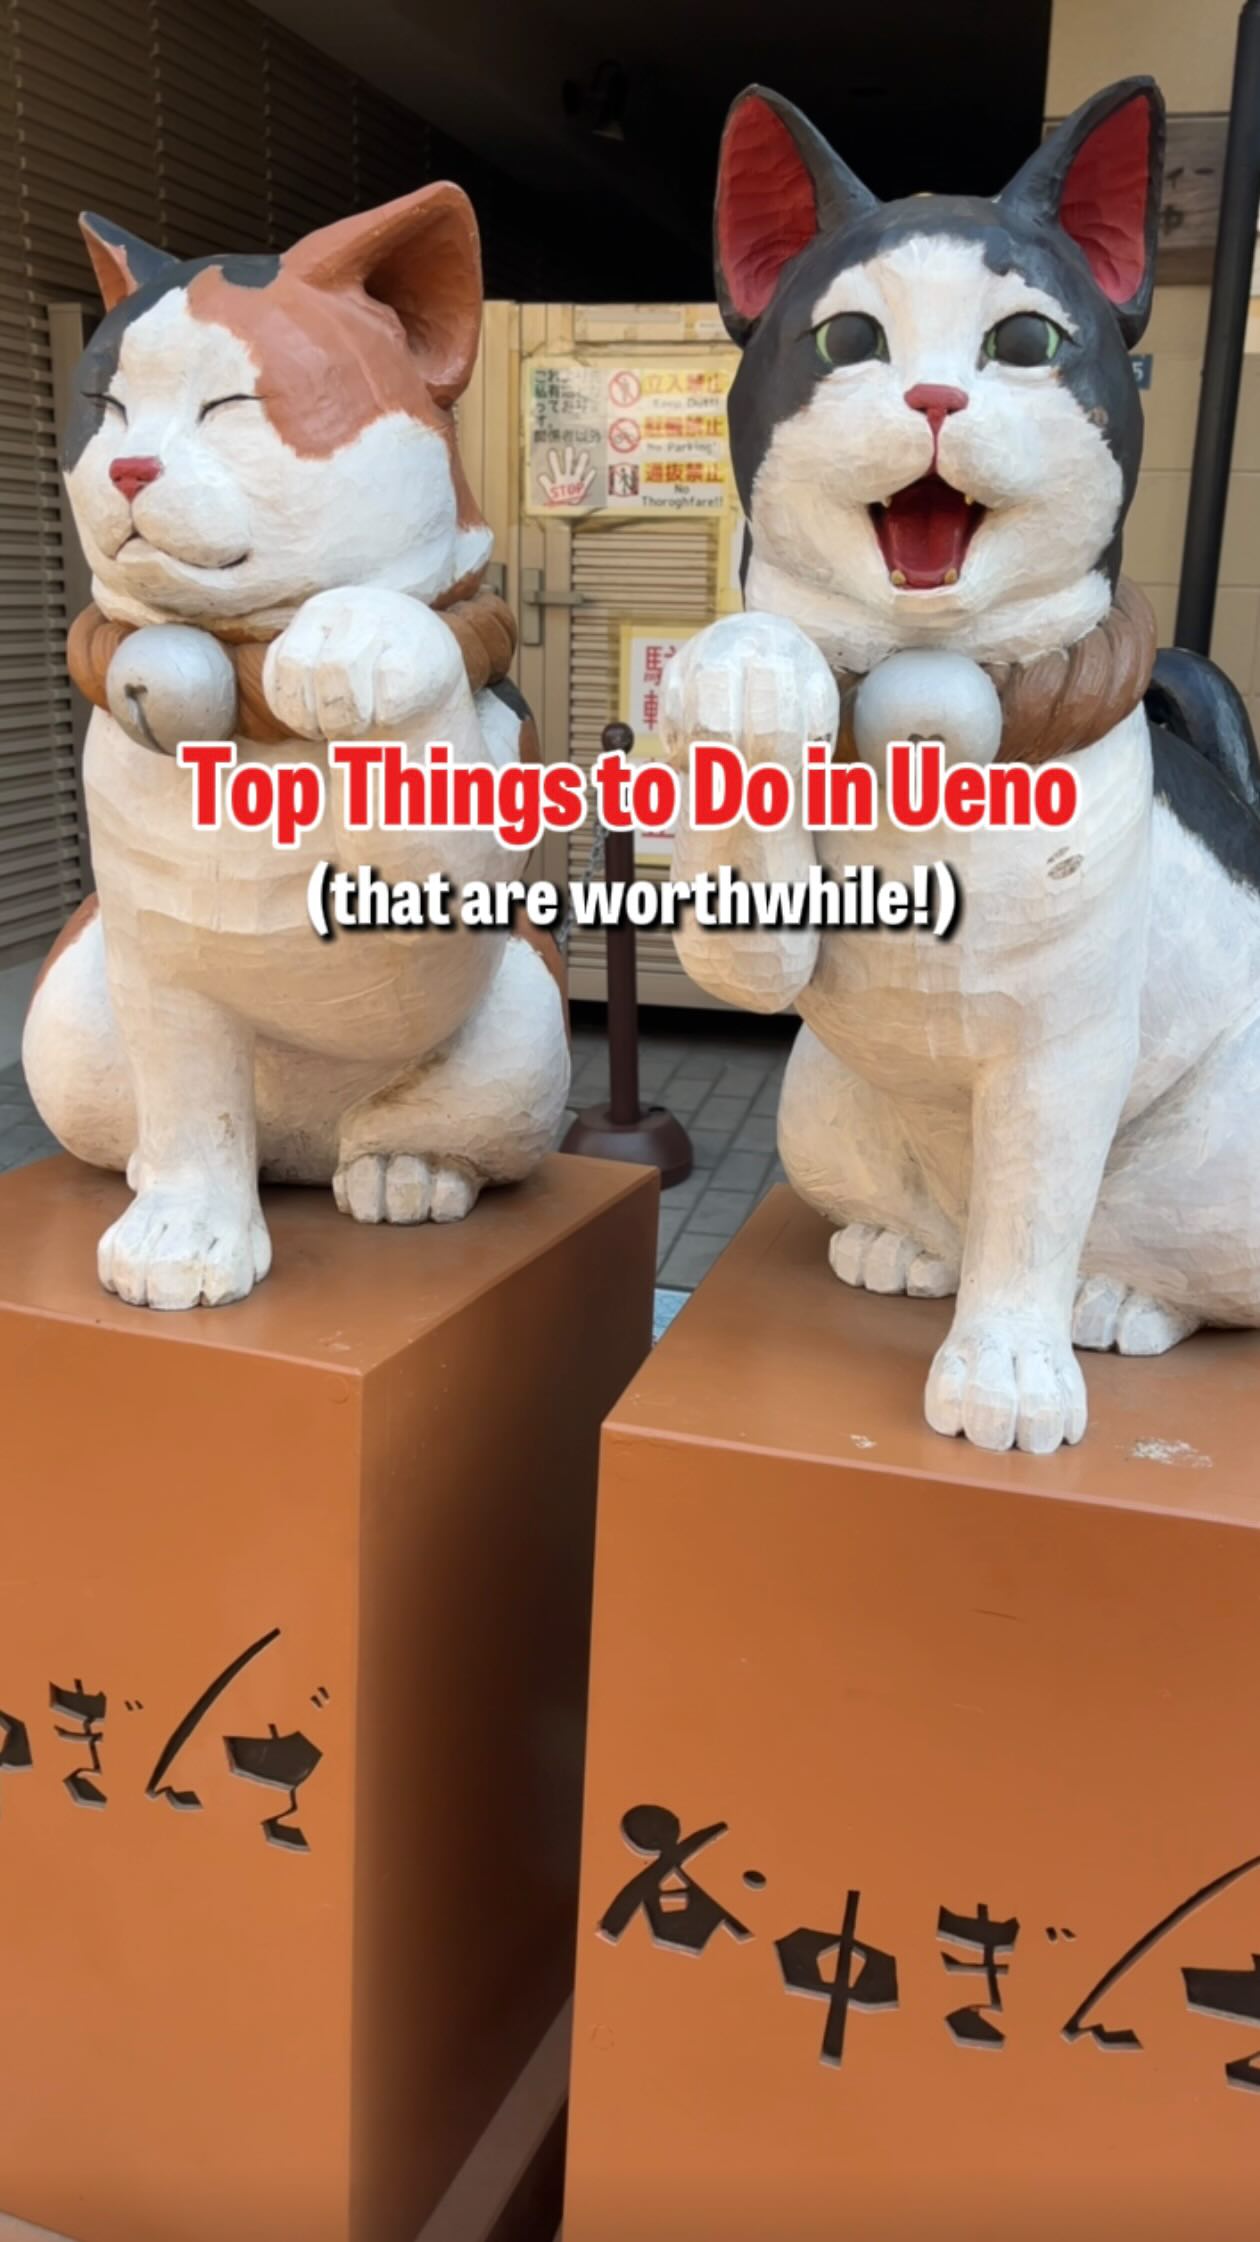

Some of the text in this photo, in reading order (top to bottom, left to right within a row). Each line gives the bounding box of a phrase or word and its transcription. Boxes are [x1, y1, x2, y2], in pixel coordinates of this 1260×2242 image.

[644, 373, 724, 394] 立入禁止
[645, 463, 724, 483] 通抜禁止
[550, 482, 585, 499] STOP
[674, 484, 691, 494] No
